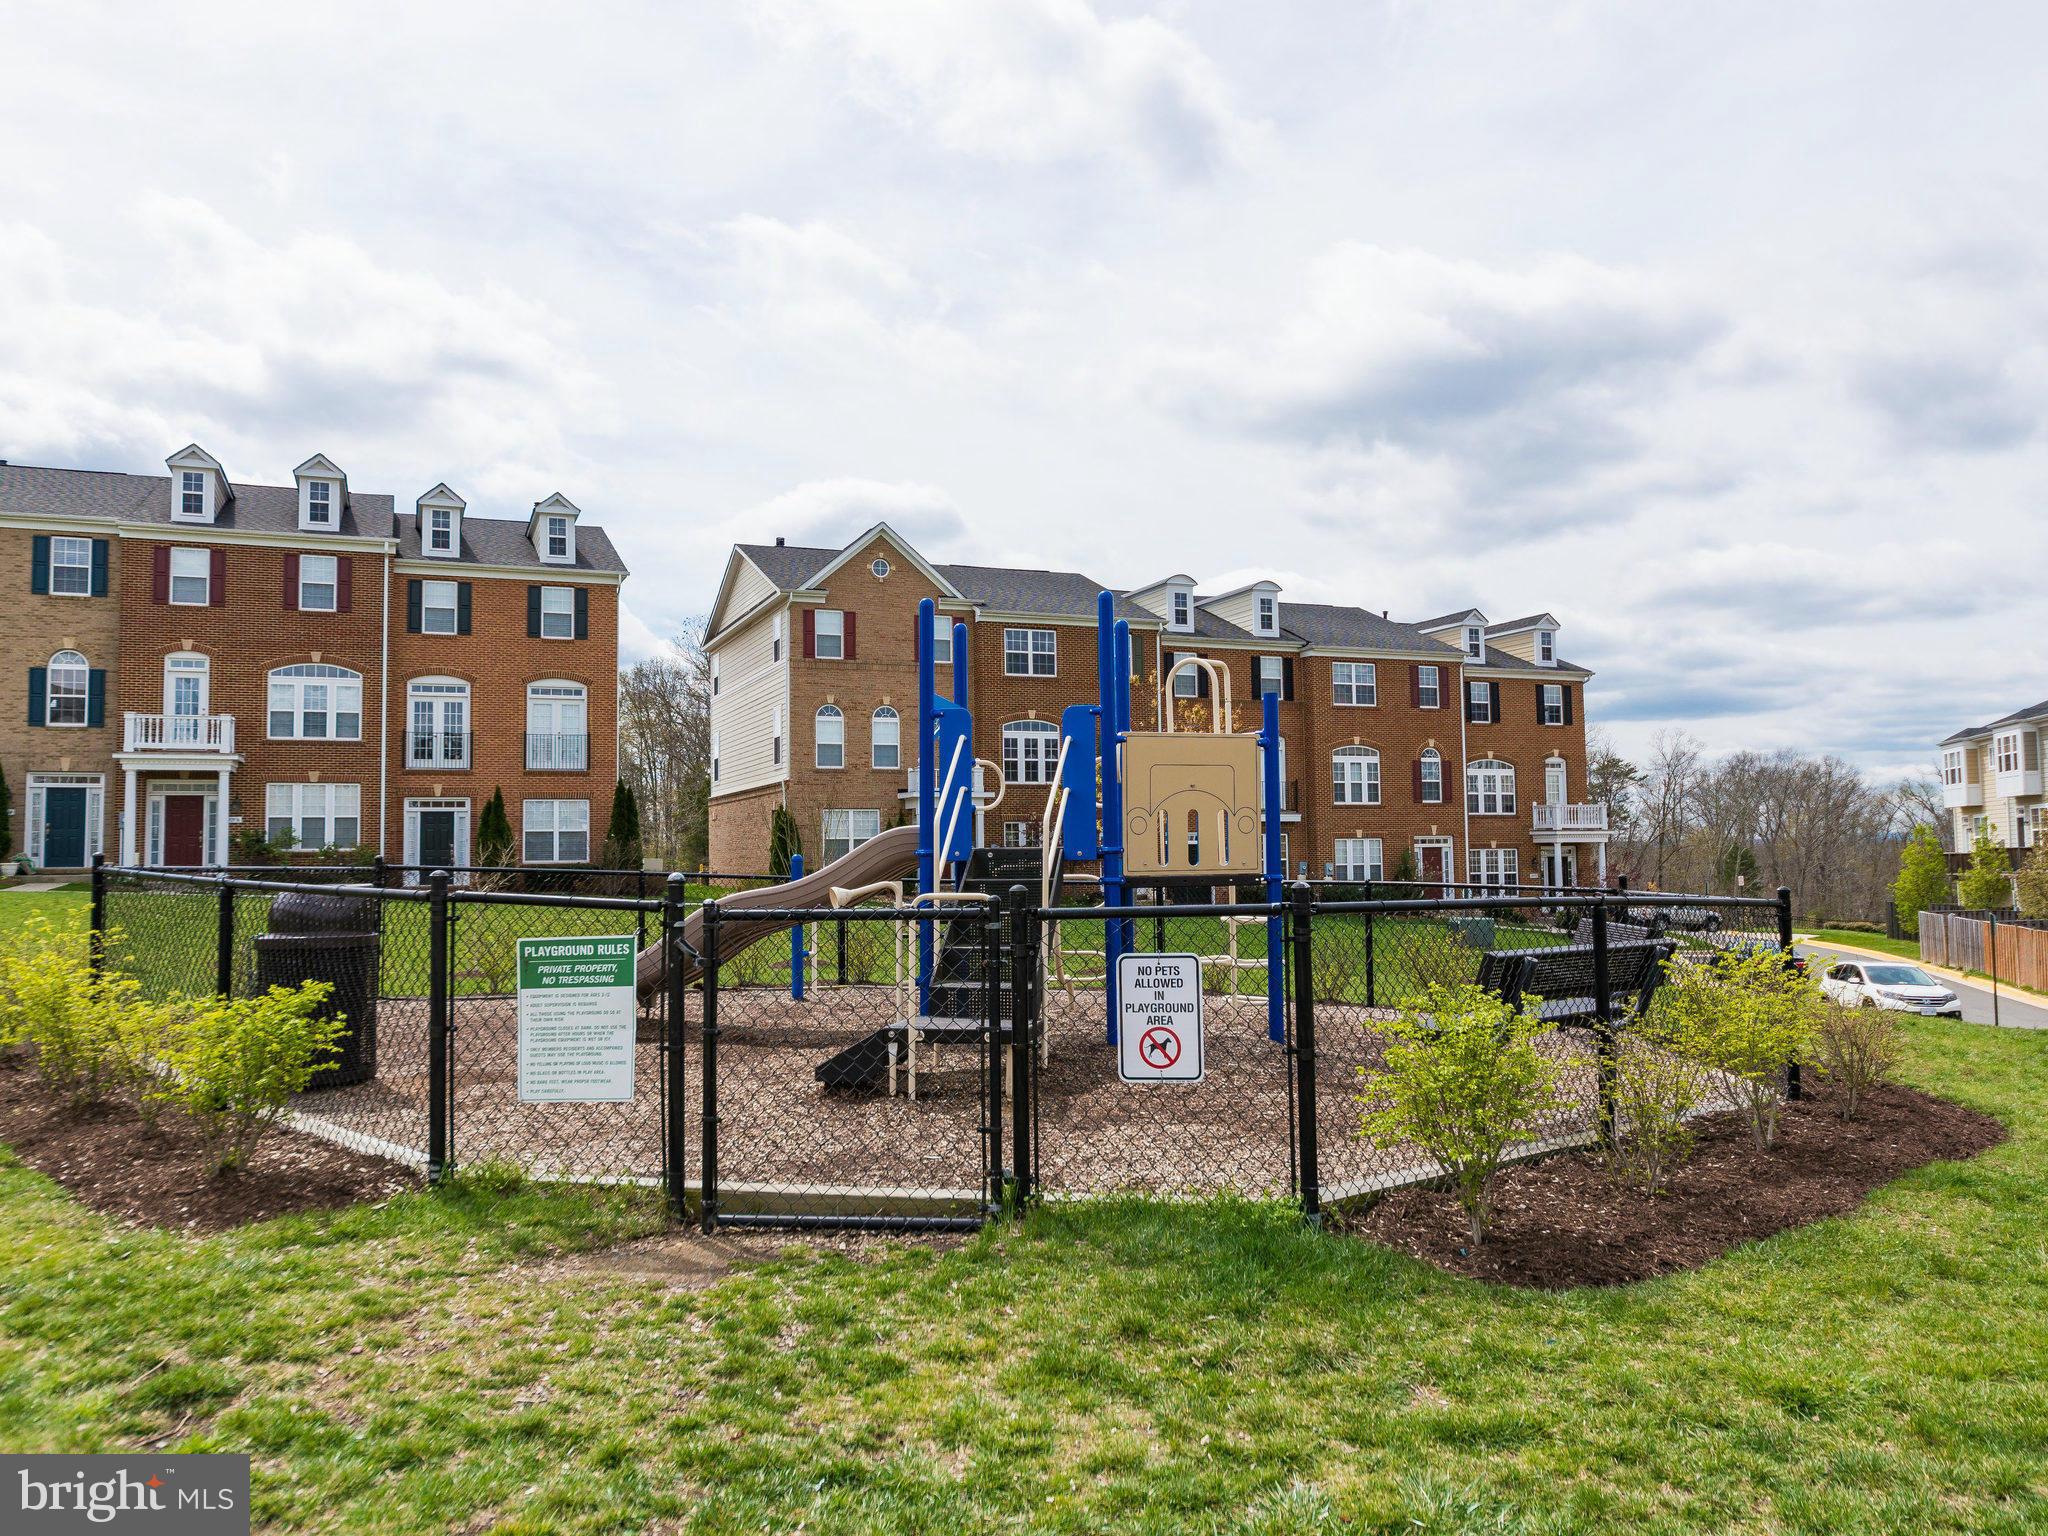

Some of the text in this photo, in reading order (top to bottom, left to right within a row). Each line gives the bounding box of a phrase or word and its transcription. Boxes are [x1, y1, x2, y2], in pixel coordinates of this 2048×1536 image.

[525, 944, 629, 957] PLAYGROUND RULES
[538, 964, 618, 973] PRIVATE PROPERTY,
[1138, 966, 1179, 976] NO PETS
[559, 975, 614, 984] TRESPASSING
[1135, 979, 1183, 988] ALLOWED
[1154, 991, 1164, 1000] IN
[1126, 1003, 1194, 1013] PLAYGROUND
[1147, 1016, 1173, 1025] AREA
